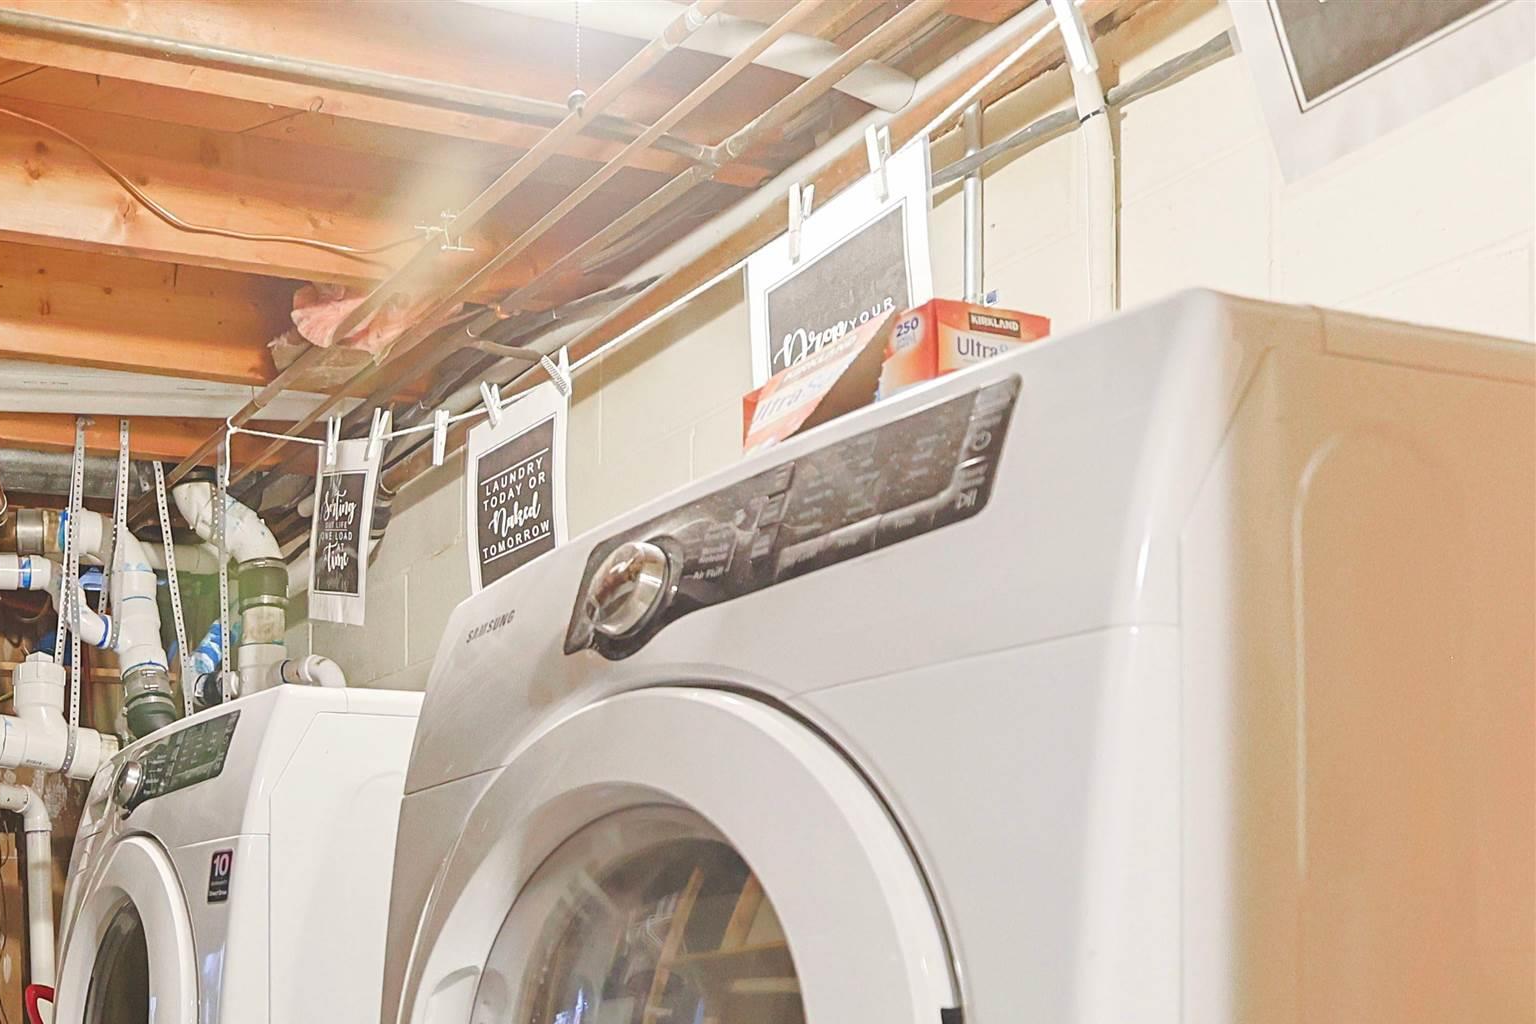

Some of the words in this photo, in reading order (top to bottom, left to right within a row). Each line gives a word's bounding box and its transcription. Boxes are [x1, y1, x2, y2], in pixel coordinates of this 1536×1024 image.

[849, 297, 894, 328] YOUR
[895, 317, 919, 338] 250
[971, 314, 1020, 331] KIRKLAND
[957, 336, 998, 359] Ultra
[482, 483, 523, 512] TODAY
[528, 471, 546, 489] OR
[485, 457, 544, 497] LAUNDRY
[324, 489, 357, 525] Sorting
[487, 491, 541, 538] Naked
[320, 531, 332, 541] ONE
[335, 531, 353, 541] LOAD
[482, 519, 550, 559] TOMORROW
[466, 609, 515, 643] SAMSUNG
[213, 853, 230, 877] 10
